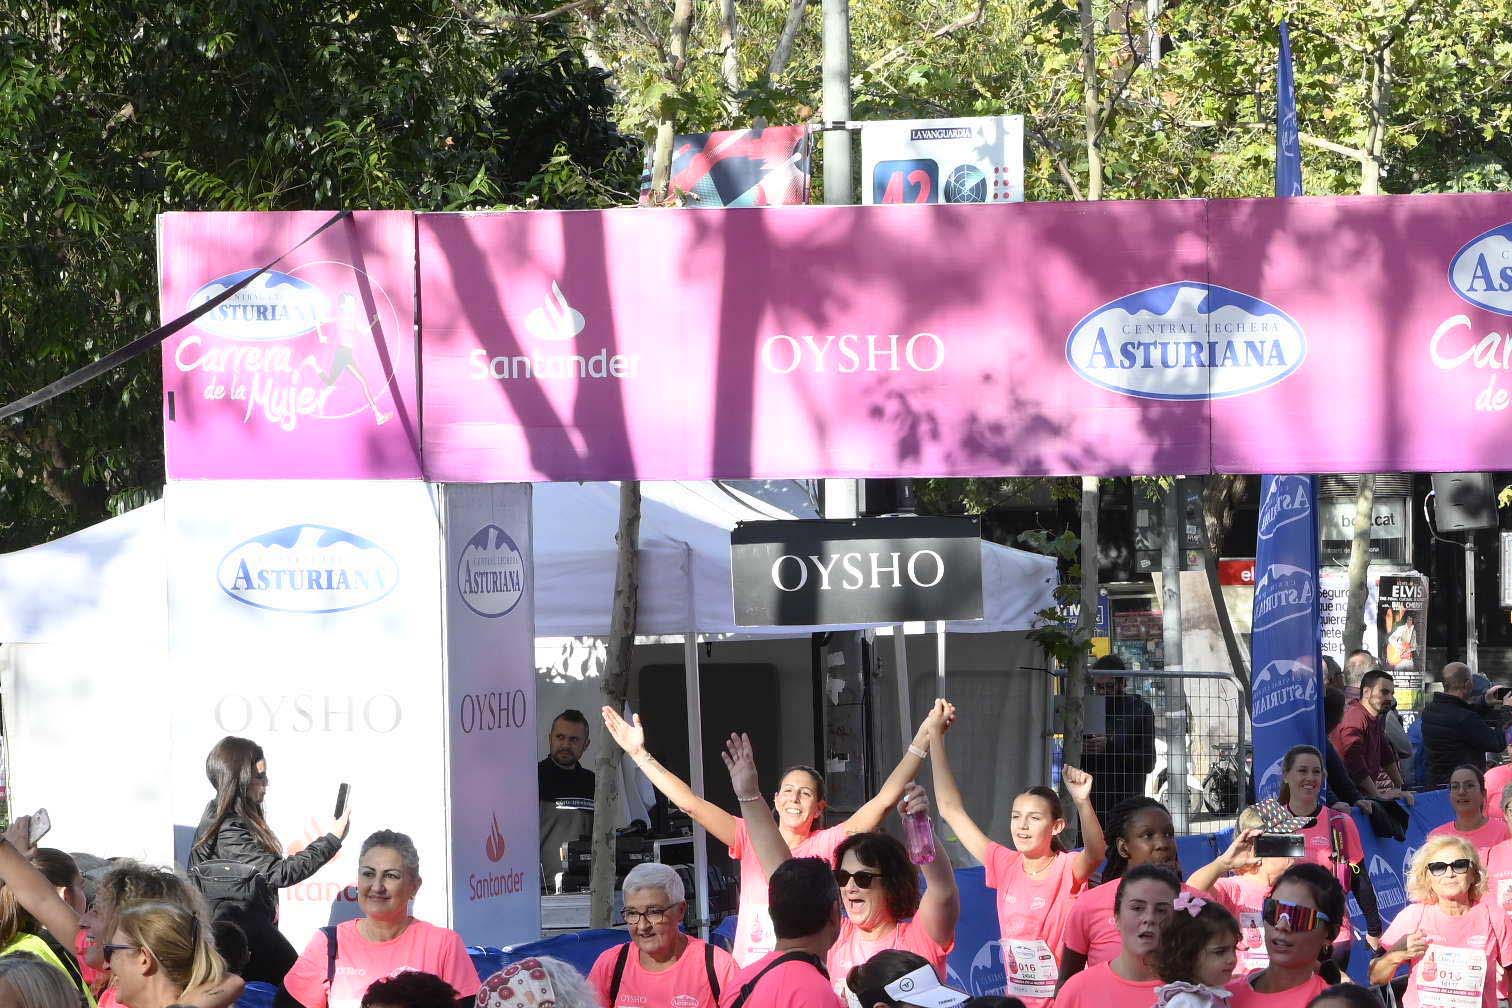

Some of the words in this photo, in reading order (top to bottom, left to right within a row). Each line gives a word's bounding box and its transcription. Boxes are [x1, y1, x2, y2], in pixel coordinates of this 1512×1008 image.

[1122, 322, 1196, 335] CENTRAL
[1204, 321, 1281, 334] LECHERA
[174, 335, 293, 373] Carrera
[468, 349, 641, 381] Santander
[761, 332, 946, 374] OYSHO
[1086, 326, 1288, 370] ASTURIANA
[243, 368, 337, 432] Mujer
[1474, 372, 1510, 412] de
[230, 557, 388, 591] ASTURIANA
[462, 564, 521, 595] ASTURIANA
[770, 549, 946, 593] OYSHO
[1391, 585, 1424, 598] ELVIS
[213, 689, 403, 735] OYSHO
[460, 688, 527, 734] OYSHO
[468, 869, 526, 902] Santander
[1018, 962, 1037, 973] 016
